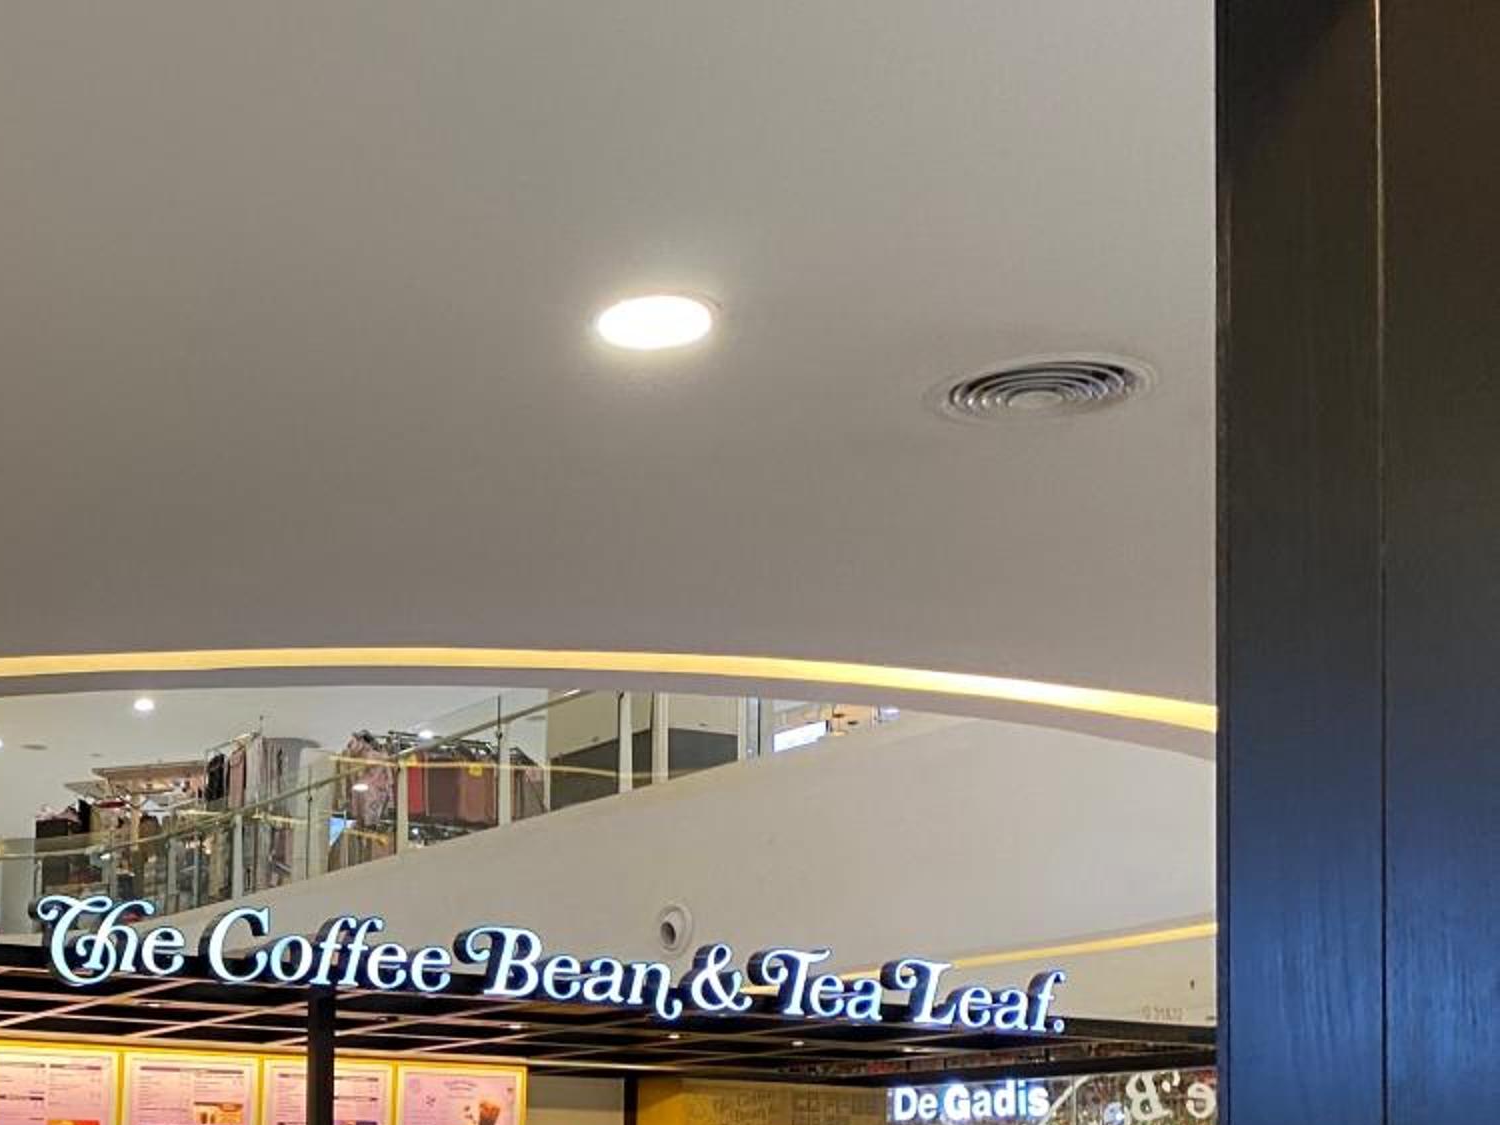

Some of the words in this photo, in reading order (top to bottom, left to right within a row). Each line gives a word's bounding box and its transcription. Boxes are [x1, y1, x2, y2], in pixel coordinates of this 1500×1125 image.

[37, 894, 186, 987] The
[206, 907, 453, 994] Coffee
[464, 925, 682, 1020] Bean
[690, 943, 754, 1012] &
[762, 948, 884, 1022] Tea
[895, 957, 1067, 1034] Leaf.
[893, 1086, 938, 1121] De
[943, 1078, 1051, 1121] Gadis
